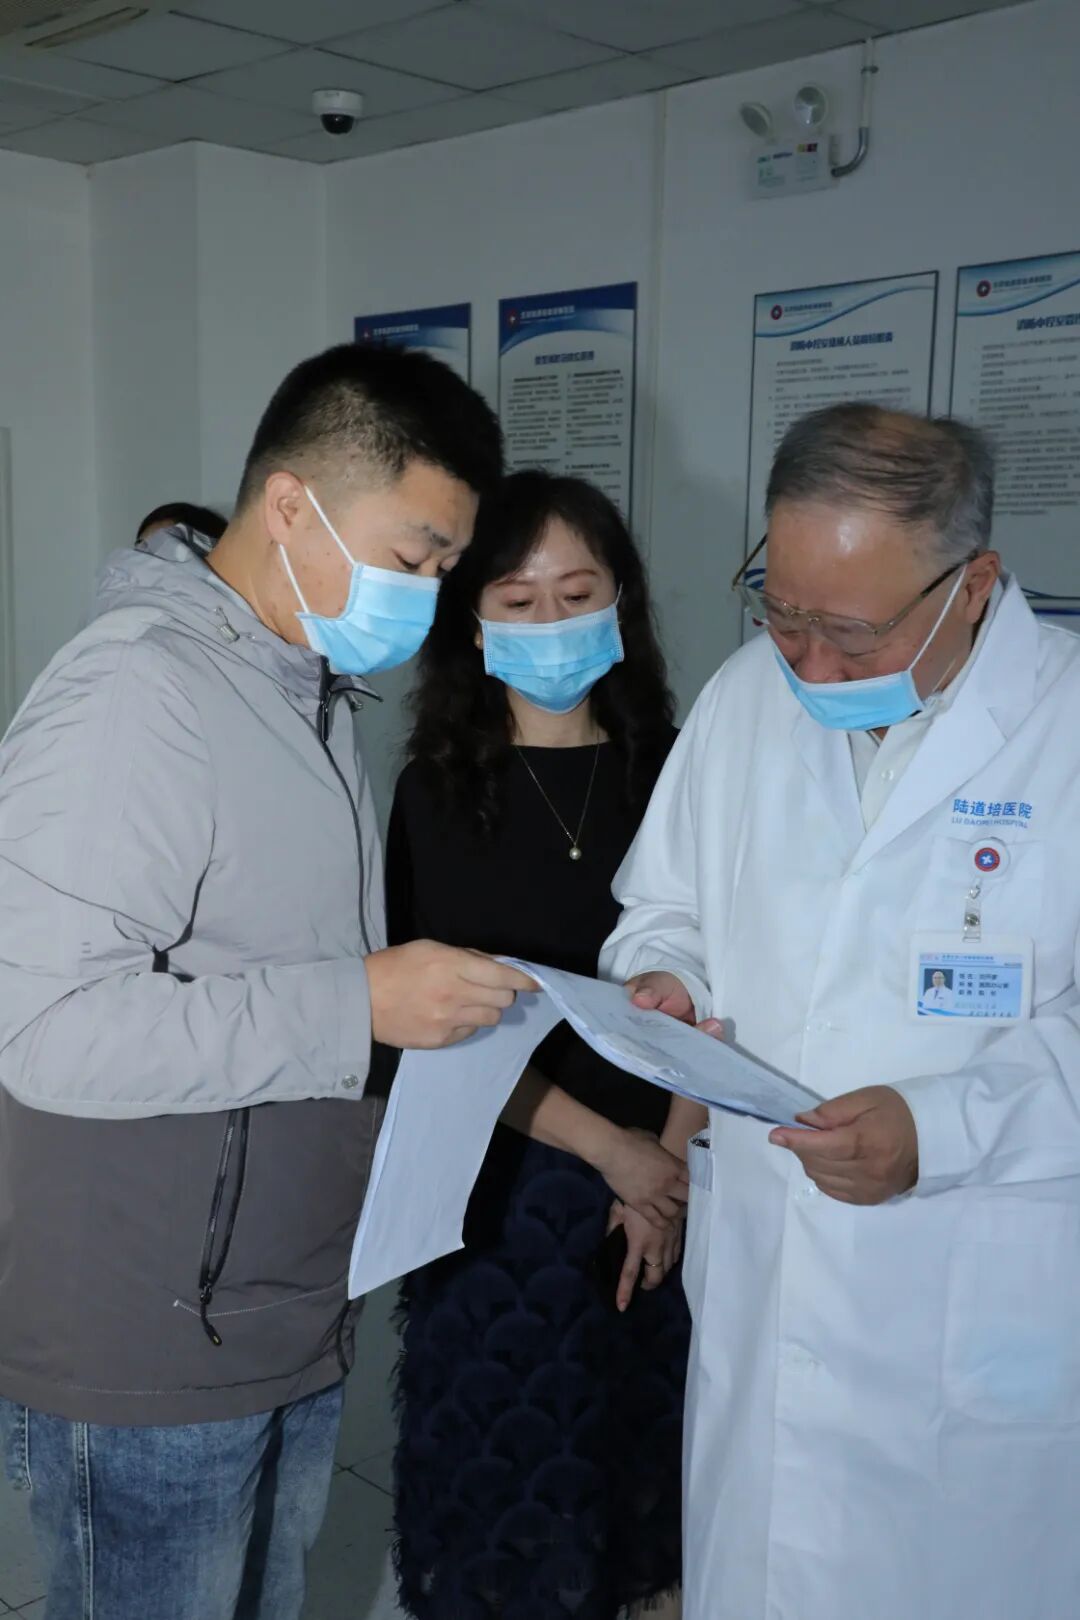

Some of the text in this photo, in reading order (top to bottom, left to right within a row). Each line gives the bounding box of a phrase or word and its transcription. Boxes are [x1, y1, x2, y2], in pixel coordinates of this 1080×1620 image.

[953, 799, 1032, 819] 陆道培医院
[994, 819, 1028, 828] HOSPITAL
